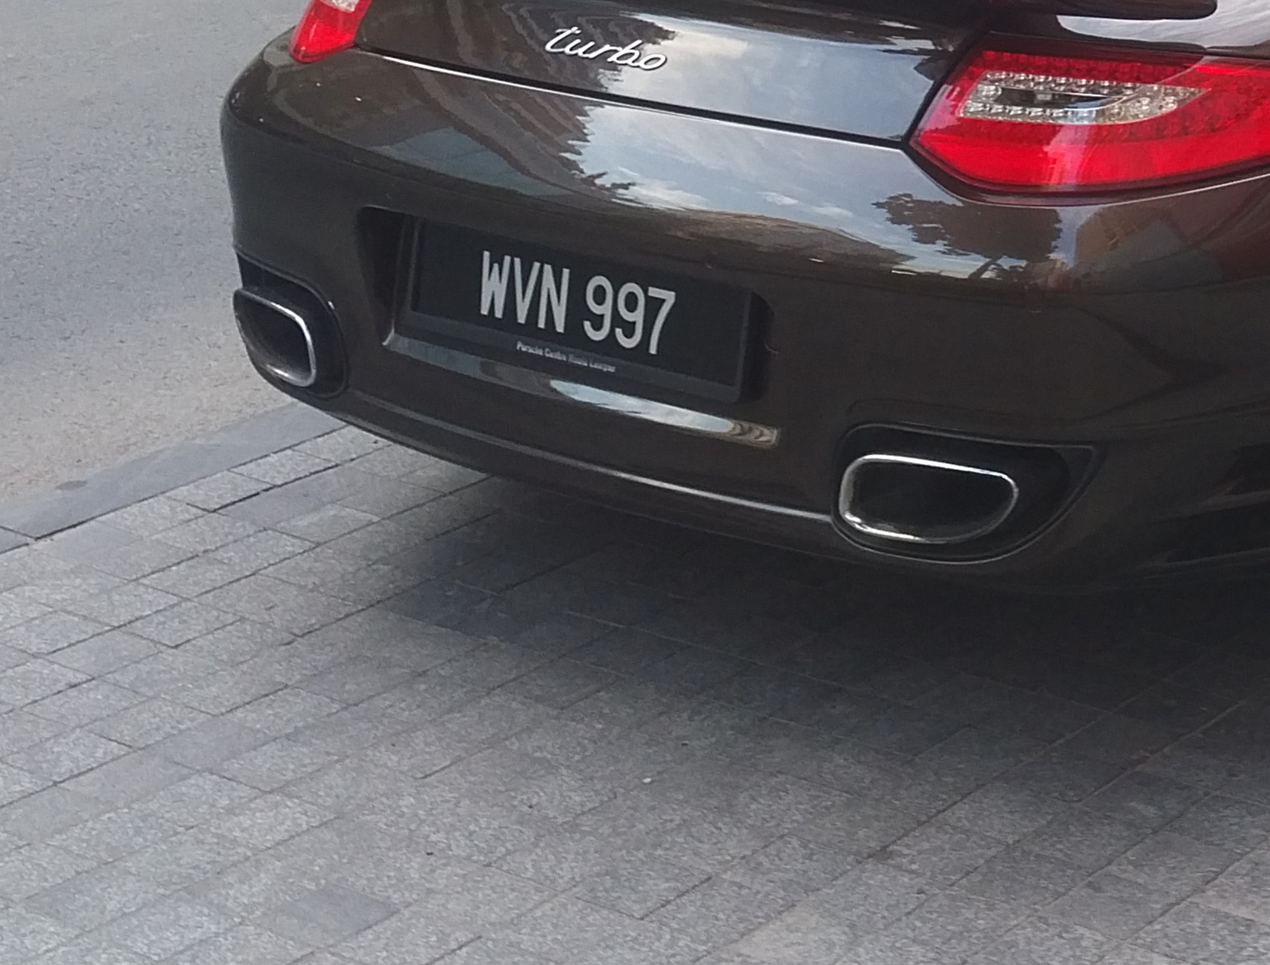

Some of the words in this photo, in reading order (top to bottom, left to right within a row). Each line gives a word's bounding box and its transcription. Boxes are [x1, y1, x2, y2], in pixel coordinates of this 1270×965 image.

[545, 26, 668, 70] turbo
[480, 250, 571, 333] WVN
[583, 275, 676, 355] 997
